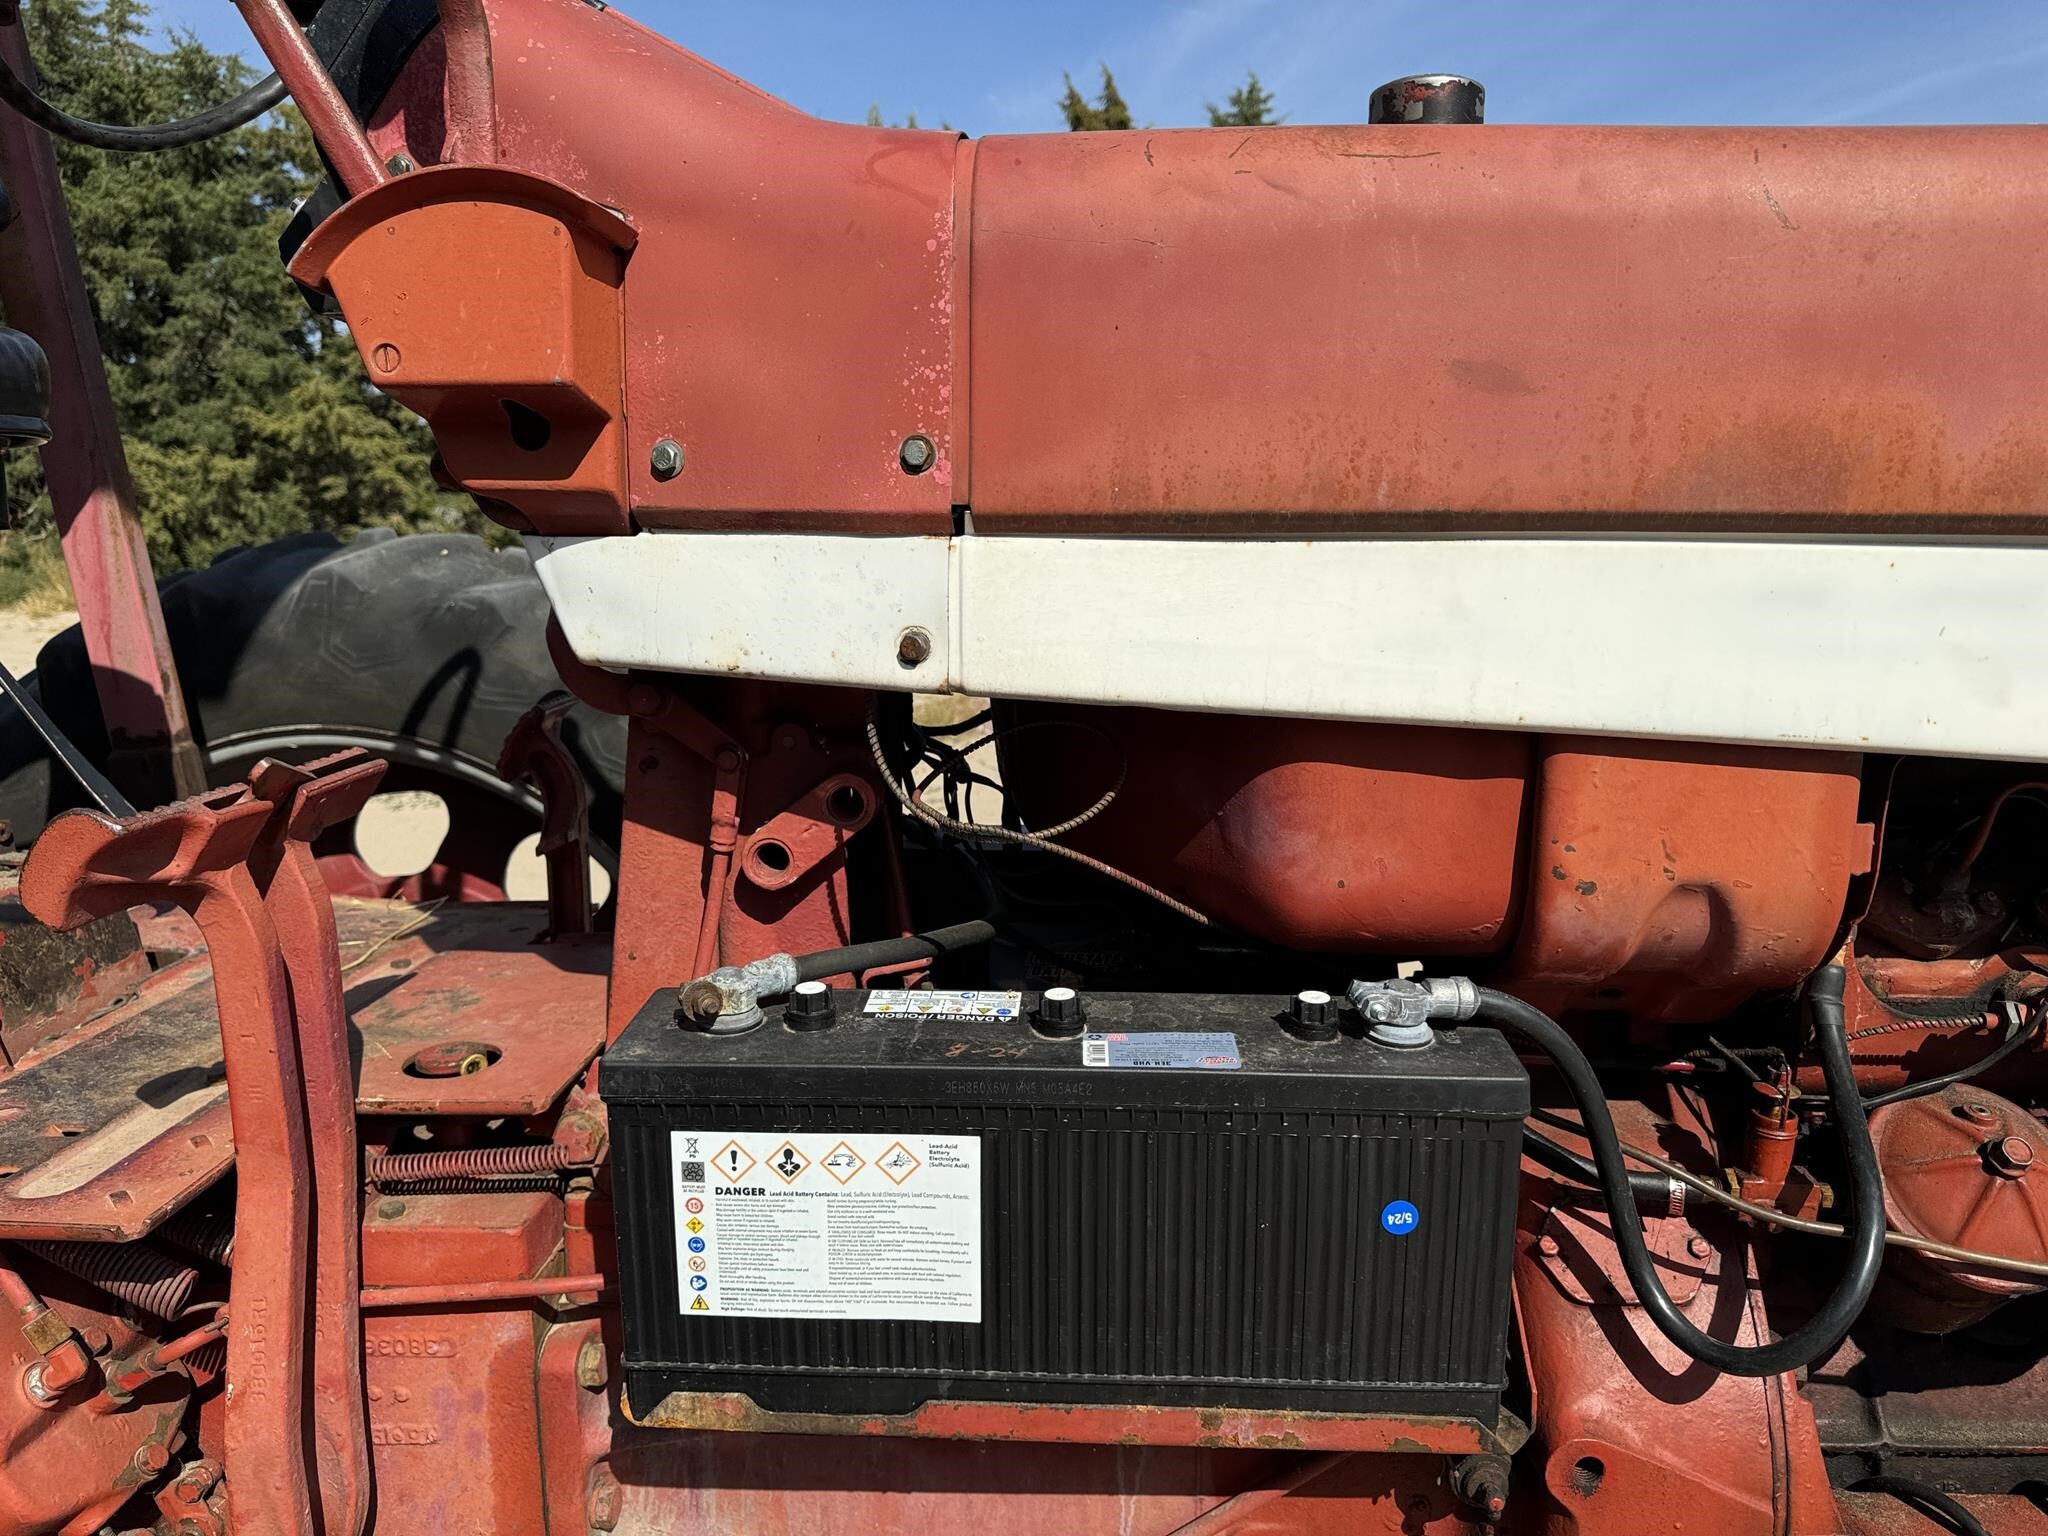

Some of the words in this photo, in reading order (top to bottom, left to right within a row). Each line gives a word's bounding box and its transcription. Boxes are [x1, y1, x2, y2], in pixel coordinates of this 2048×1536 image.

[937, 1013, 994, 1022] DANGER
[928, 1155, 960, 1163] Electrolyte
[928, 1161, 953, 1169] (Sulfuric
[715, 1186, 766, 1197] DANGER
[795, 1191, 814, 1199] Battery
[1387, 1212, 1412, 1225] 5/24
